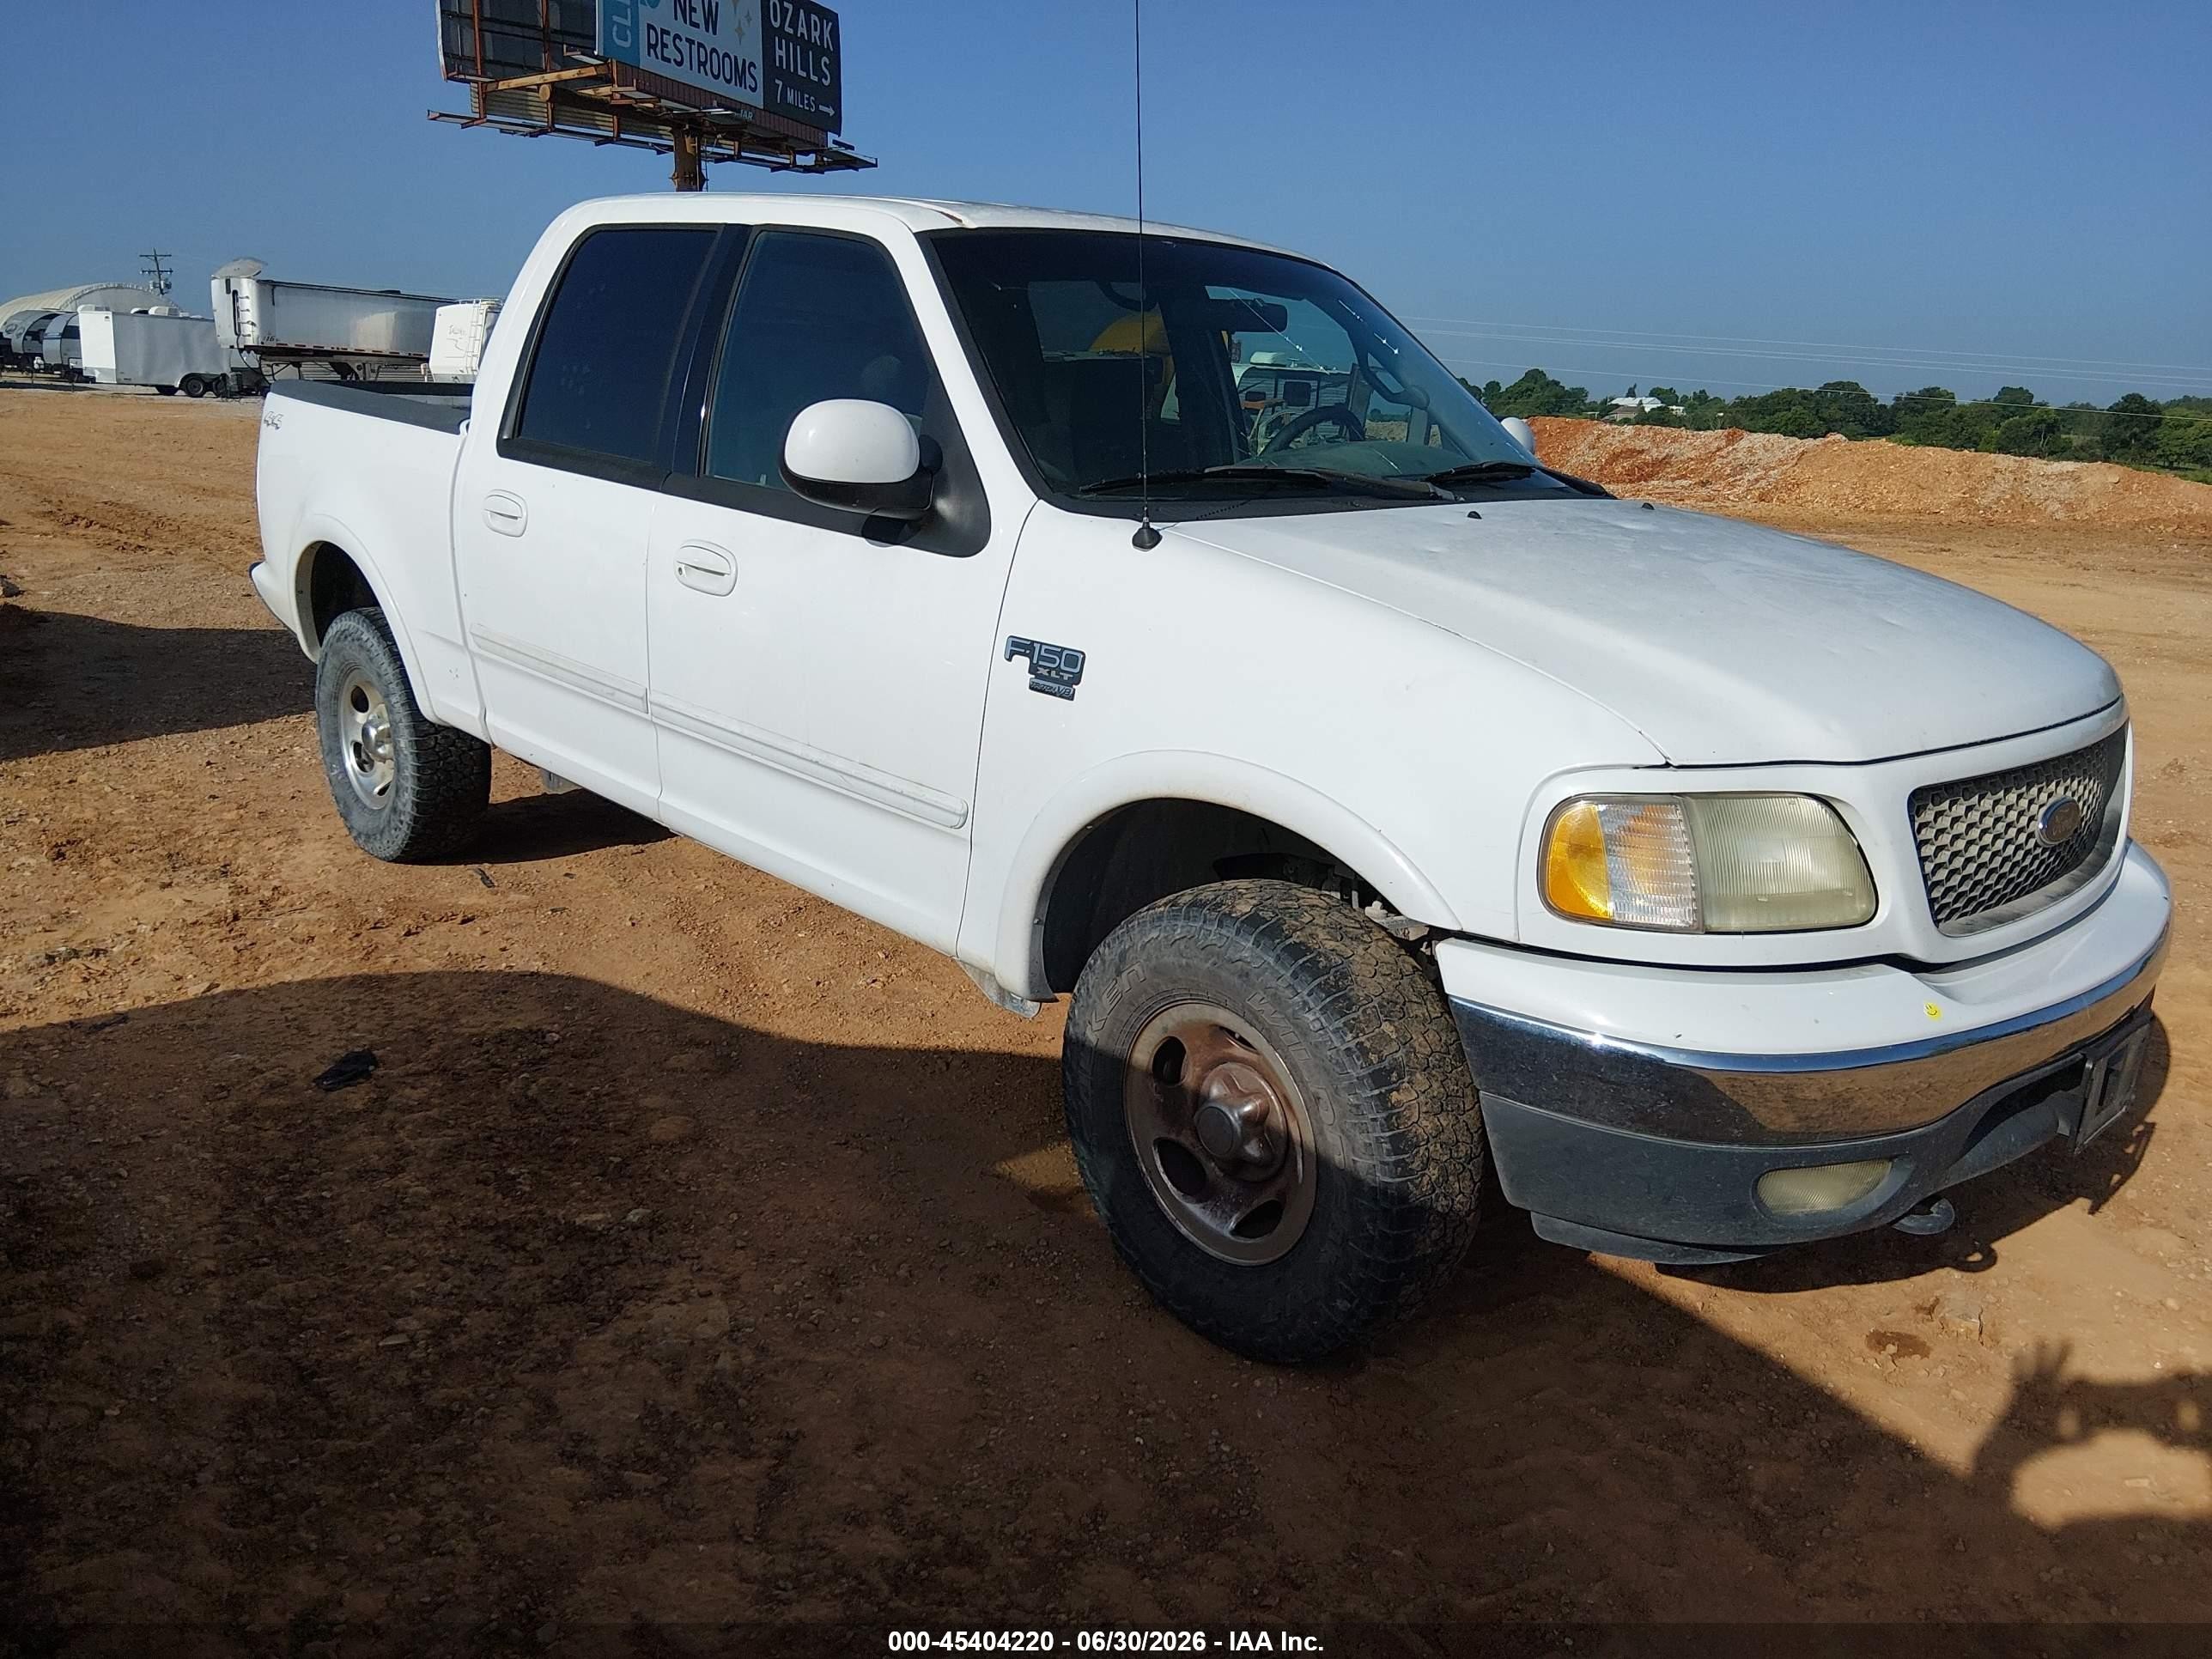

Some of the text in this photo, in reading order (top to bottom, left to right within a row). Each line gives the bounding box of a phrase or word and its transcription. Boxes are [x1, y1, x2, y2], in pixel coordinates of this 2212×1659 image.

[612, 0, 631, 48] CL
[673, 0, 719, 36] NEW
[769, 0, 833, 52] OZARK
[647, 22, 757, 93] RESTROOMS
[775, 36, 830, 87] HILLS
[775, 79, 816, 113] 7 MILES
[1036, 666, 1073, 681] XLT
